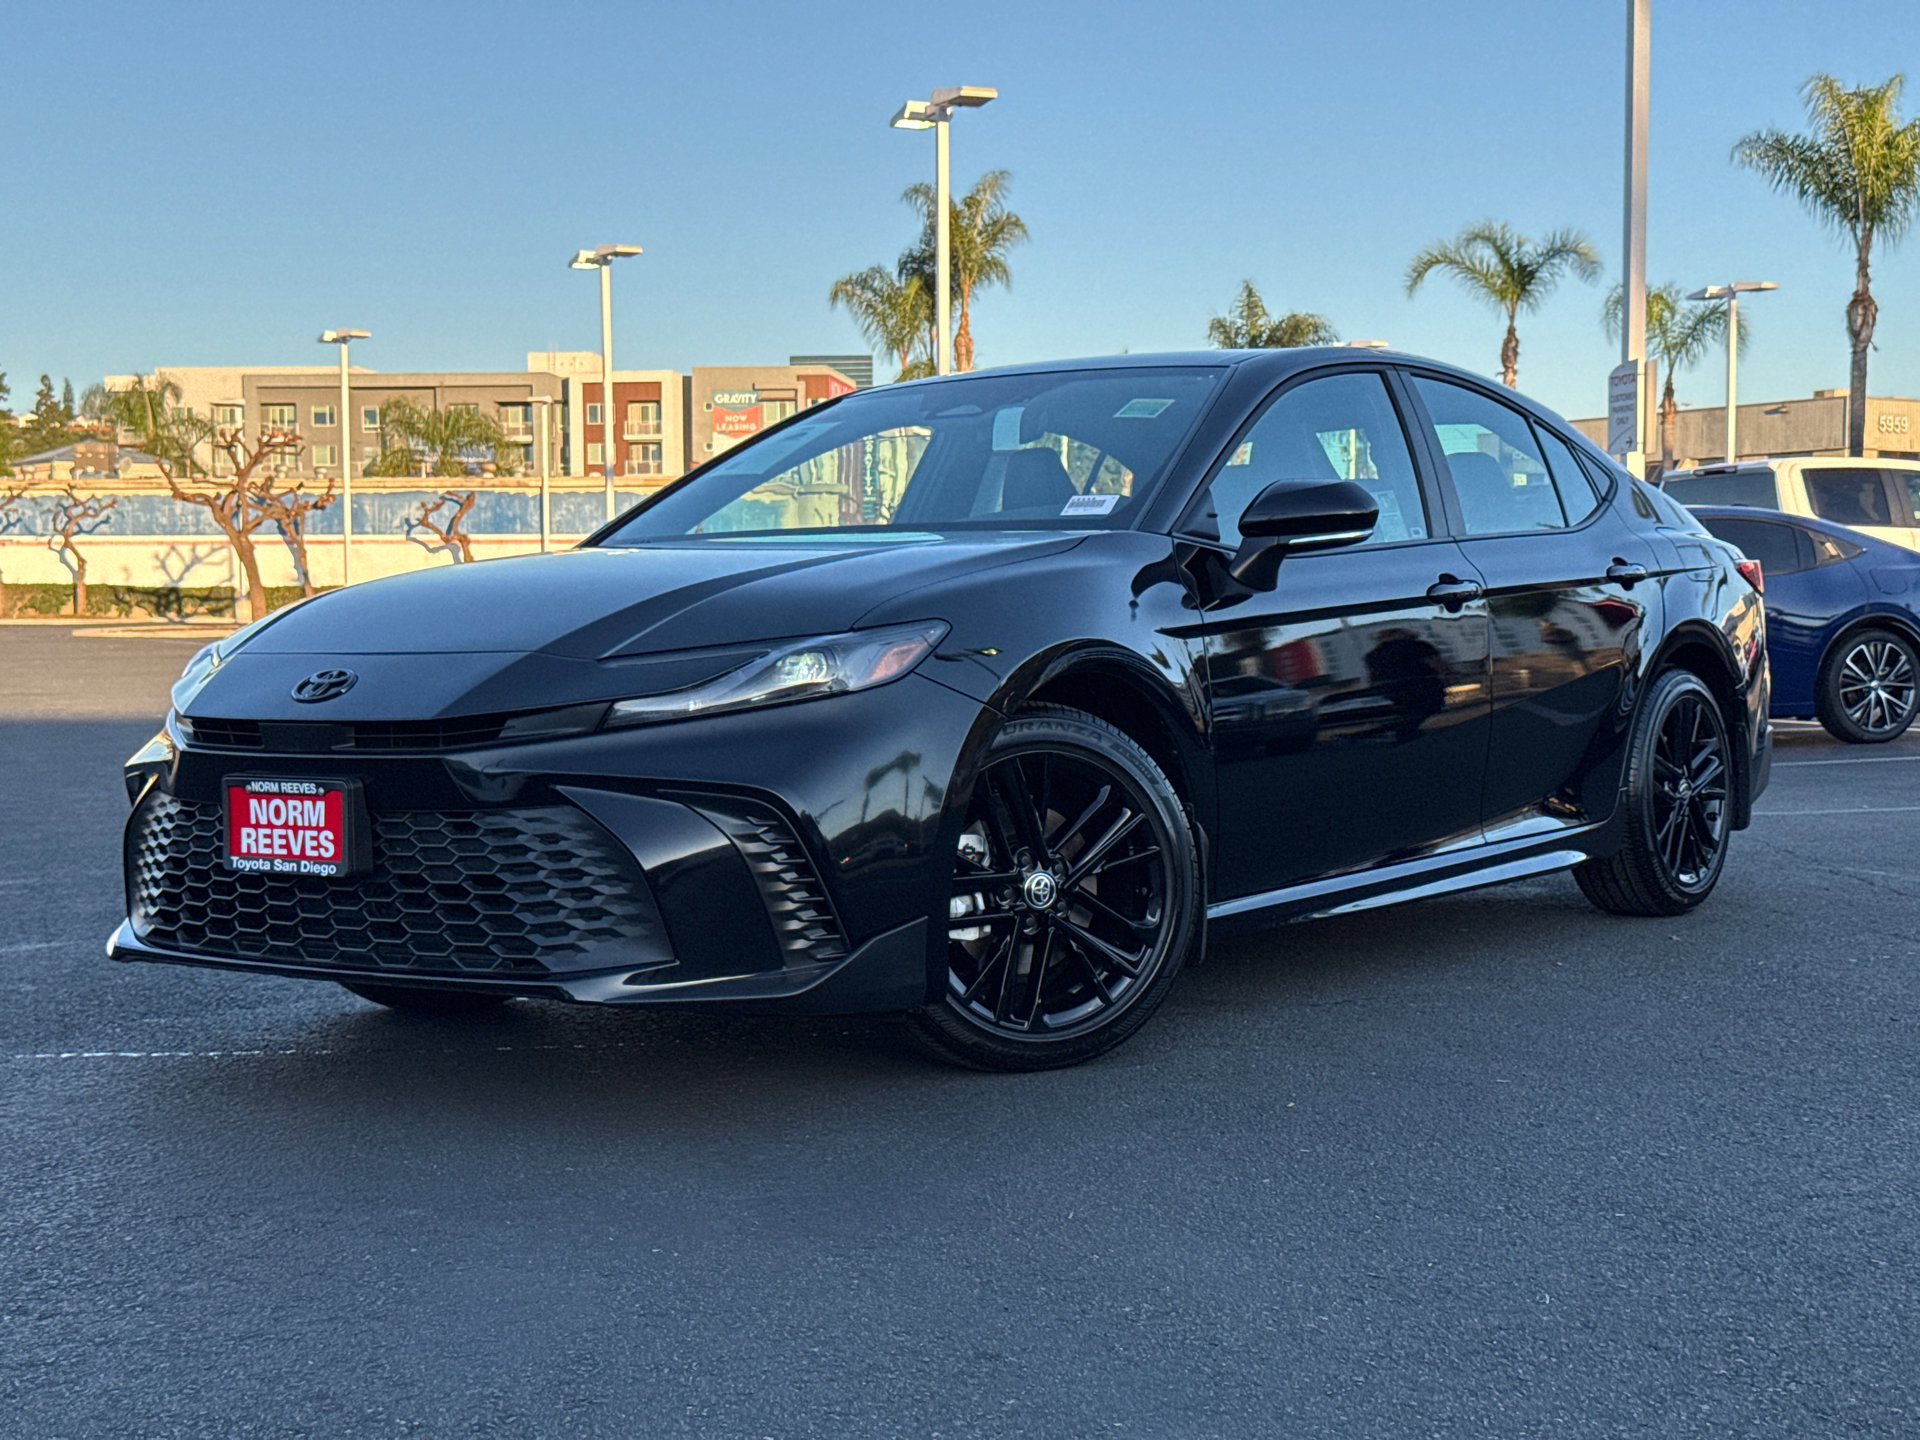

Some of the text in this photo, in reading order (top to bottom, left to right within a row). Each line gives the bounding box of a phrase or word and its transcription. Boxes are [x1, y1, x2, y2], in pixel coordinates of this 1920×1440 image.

[714, 393, 758, 404] GRAVITY
[715, 423, 757, 431] LEASING
[725, 414, 748, 423] NOW
[1878, 414, 1908, 433] 5959
[1001, 720, 1103, 743] URANZA
[250, 780, 317, 795] NORM REEVES
[249, 798, 325, 827] NORM
[241, 827, 335, 858] REEVES
[230, 856, 337, 877] Toyota San Diego
